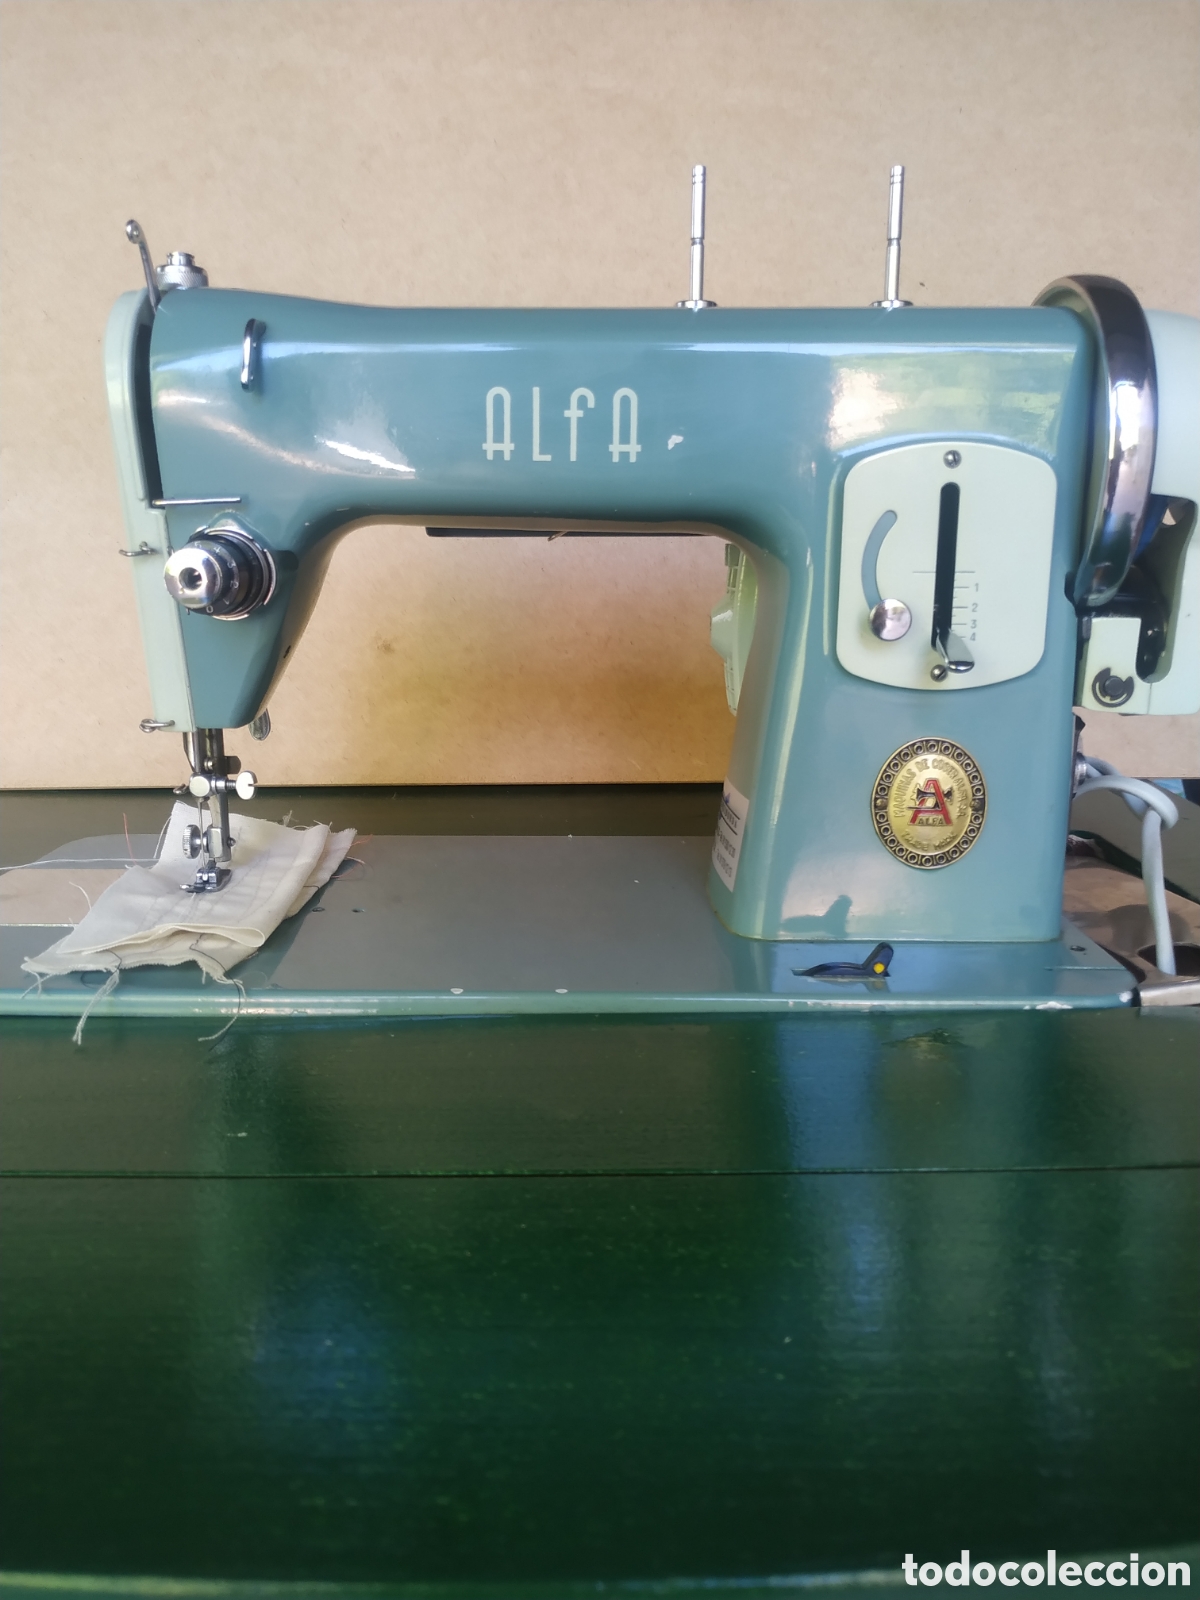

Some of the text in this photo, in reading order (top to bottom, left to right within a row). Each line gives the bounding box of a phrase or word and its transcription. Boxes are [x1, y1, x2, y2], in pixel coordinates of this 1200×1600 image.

[213, 546, 221, 554] 4
[227, 560, 237, 569] 3
[230, 580, 239, 589] 2
[974, 582, 980, 592] 1
[971, 602, 979, 613] 2
[970, 619, 978, 629] 3
[969, 632, 977, 641] 4
[893, 768, 917, 819] MAQUINAS
[914, 758, 931, 773] DE
[917, 817, 945, 826] ALFA
